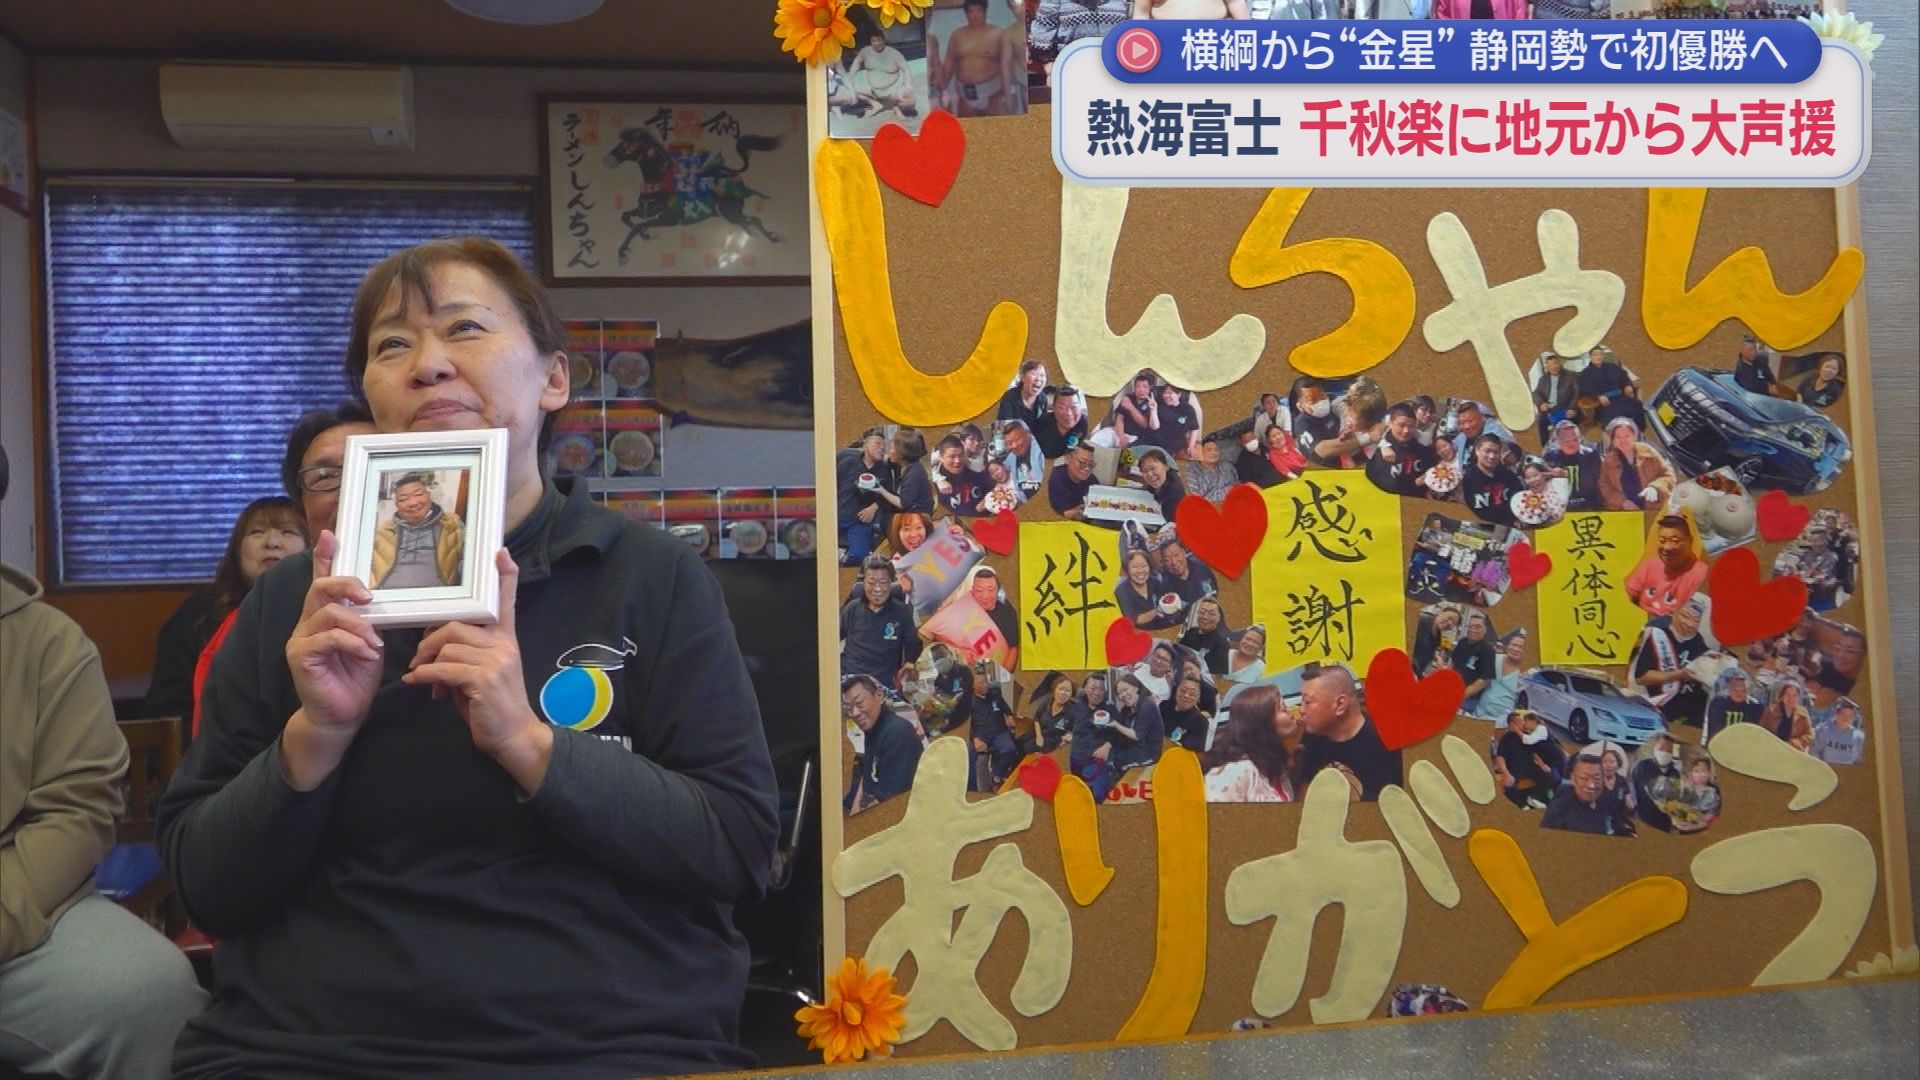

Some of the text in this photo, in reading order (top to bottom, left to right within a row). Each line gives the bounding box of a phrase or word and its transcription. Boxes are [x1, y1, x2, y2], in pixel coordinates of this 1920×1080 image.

[1026, 531, 1116, 668] 絆
[1281, 480, 1373, 661] 感謝
[1560, 515, 1619, 659] 異体同心
[832, 724, 1876, 1052] ありがとう
